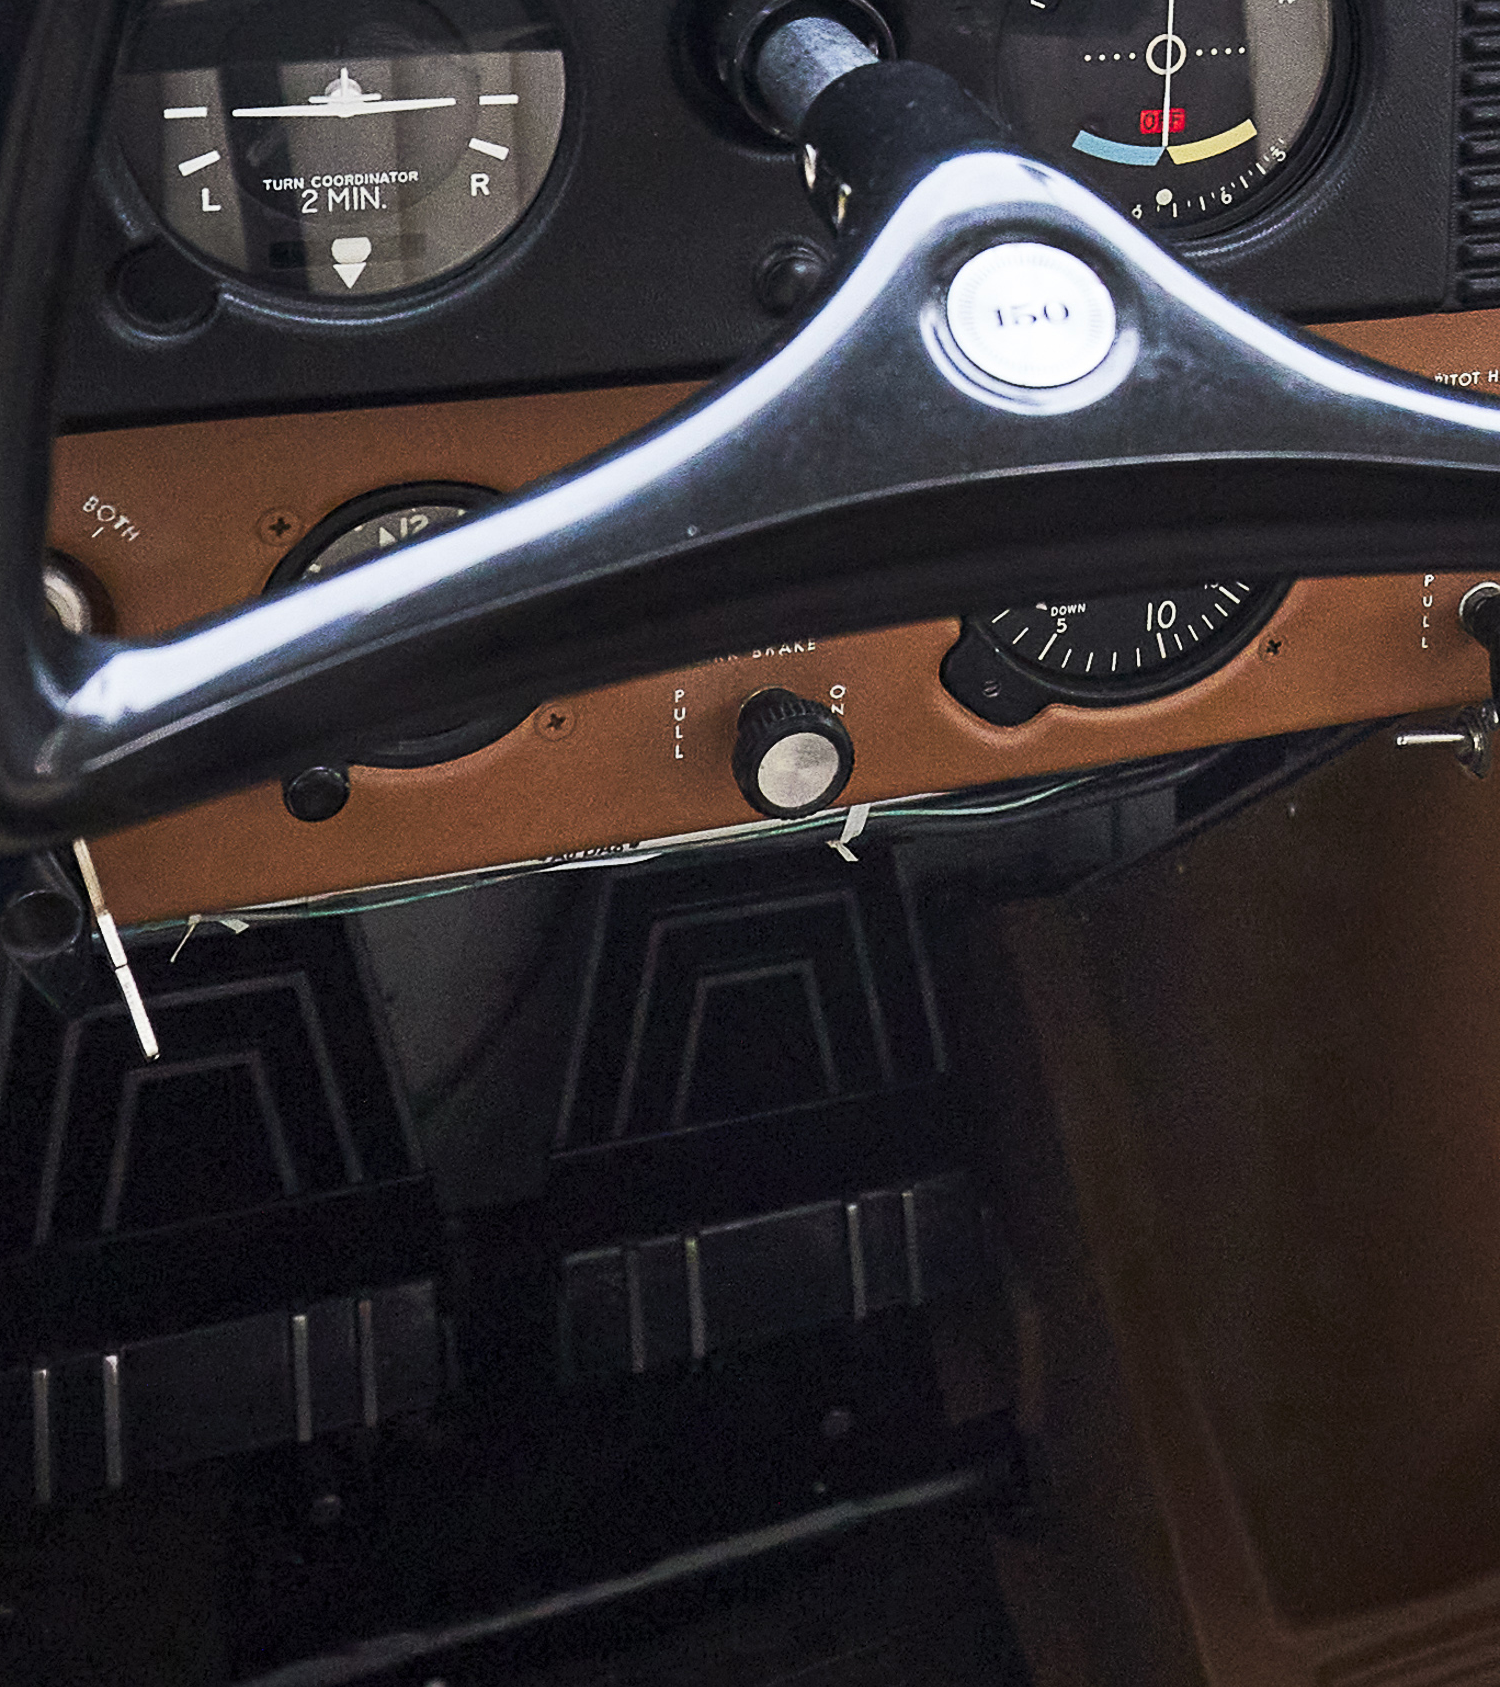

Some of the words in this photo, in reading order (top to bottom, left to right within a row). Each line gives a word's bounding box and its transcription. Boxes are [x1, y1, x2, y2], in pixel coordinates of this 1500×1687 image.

[263, 177, 305, 192] TURN
[311, 171, 419, 189] COORDINATOR
[470, 173, 490, 196] R
[201, 188, 221, 213] L
[301, 191, 318, 214] 2
[328, 186, 388, 211] MIN.
[995, 301, 1069, 328] 150
[83, 495, 141, 544] BOTH
[1051, 603, 1086, 617] DOWN
[1147, 600, 1176, 631] 10
[1056, 617, 1068, 633] 5
[674, 689, 686, 759] PULL
